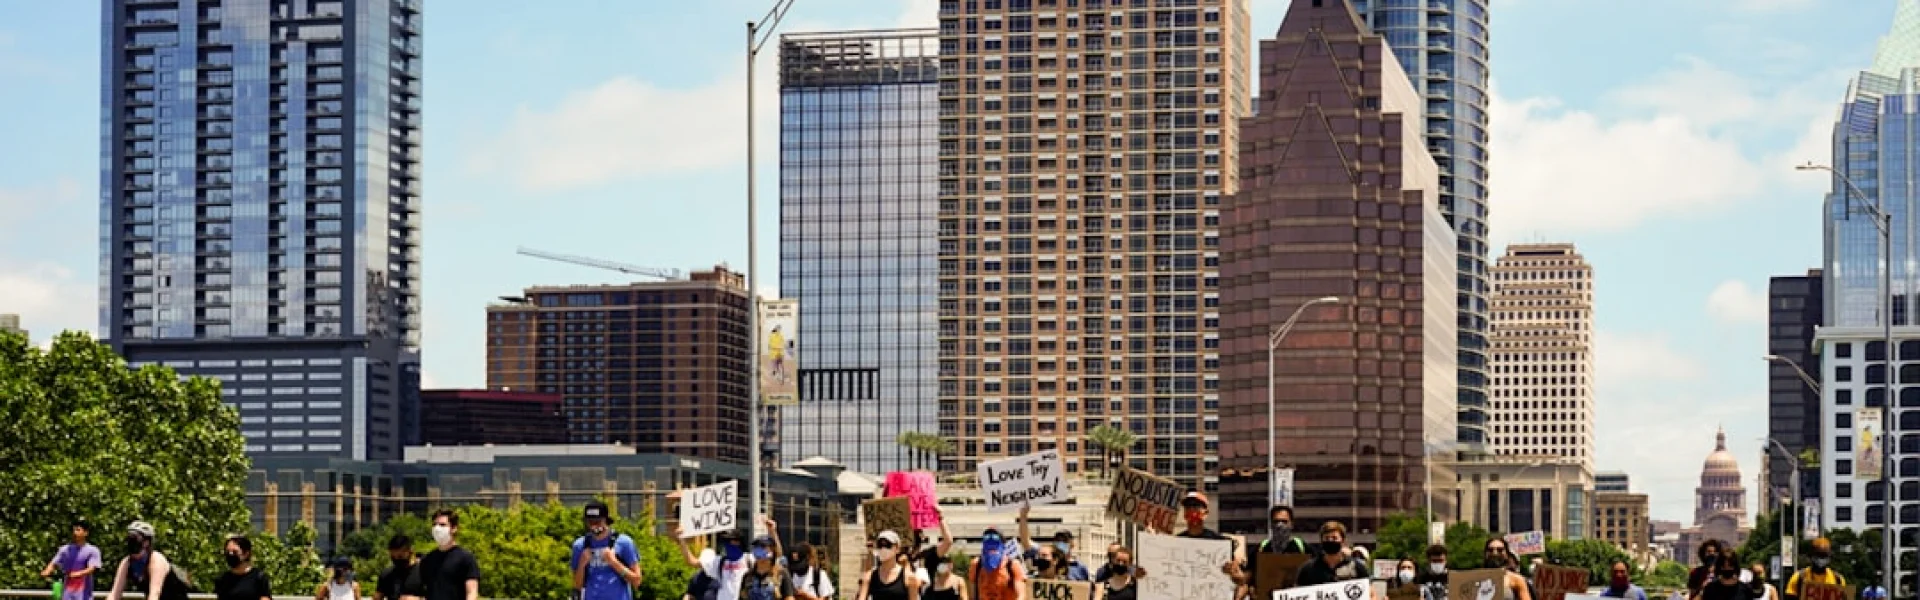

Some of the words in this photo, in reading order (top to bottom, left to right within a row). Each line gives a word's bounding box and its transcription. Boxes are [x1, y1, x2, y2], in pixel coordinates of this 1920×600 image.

[1114, 471, 1143, 494] NO
[692, 485, 732, 508] LOVE
[1108, 491, 1136, 515] NO
[691, 505, 732, 530] WINS
[1033, 582, 1073, 600] BLACK
